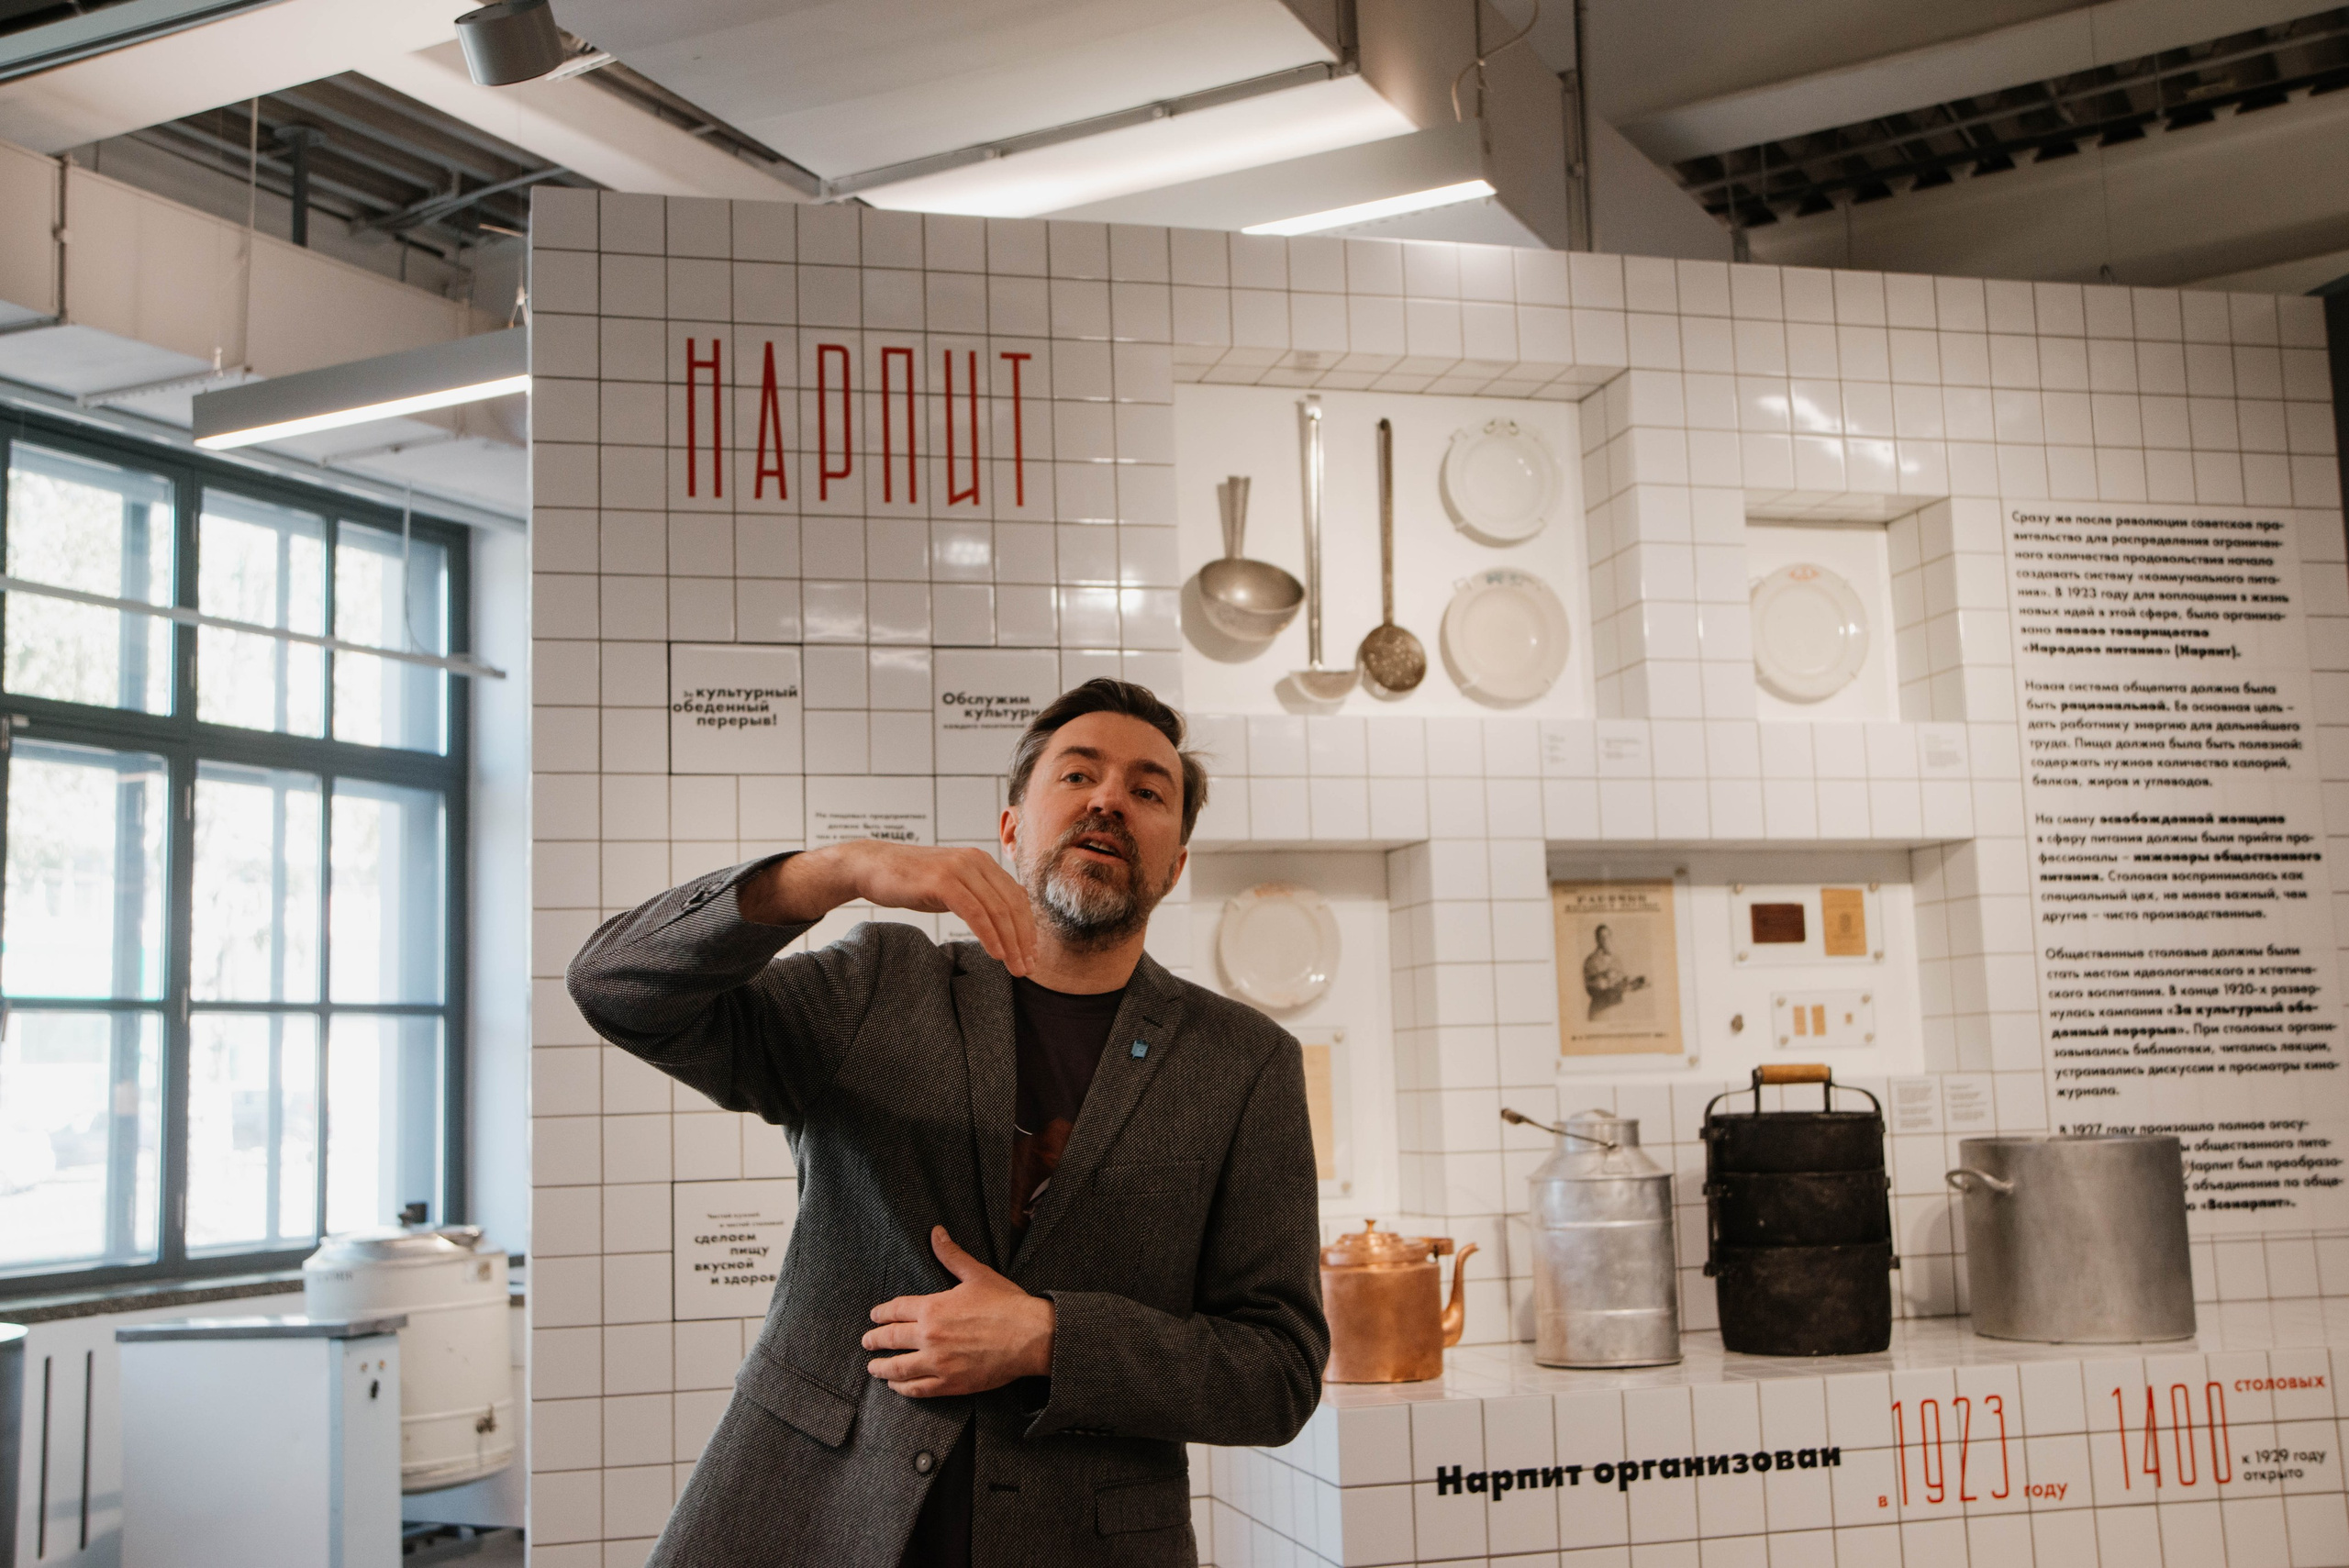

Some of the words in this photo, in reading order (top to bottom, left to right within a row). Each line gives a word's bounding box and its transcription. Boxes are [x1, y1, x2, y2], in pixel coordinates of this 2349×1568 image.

[685, 338, 1032, 507] НАРПИТ
[696, 684, 797, 701] культурный
[942, 691, 1030, 708] Обслужим
[673, 699, 770, 714] обеденный
[964, 708, 1041, 721] культурн
[696, 713, 777, 729] перерыв!
[730, 1246, 770, 1257] пищу
[695, 1258, 754, 1273] вкусной
[724, 1273, 777, 1286] здоров
[2110, 1381, 2232, 1490] 1400
[2234, 1376, 2325, 1391] столовых
[1437, 1464, 1583, 1502] Нарпит
[1593, 1446, 1842, 1492] организован
[1877, 1495, 1888, 1508] в
[1891, 1394, 2010, 1507] 1923
[2024, 1481, 2069, 1502] году
[2242, 1454, 2249, 1464] к
[2254, 1448, 2288, 1463] 1929
[2293, 1450, 2326, 1464] году
[2243, 1468, 2303, 1483] открыто
